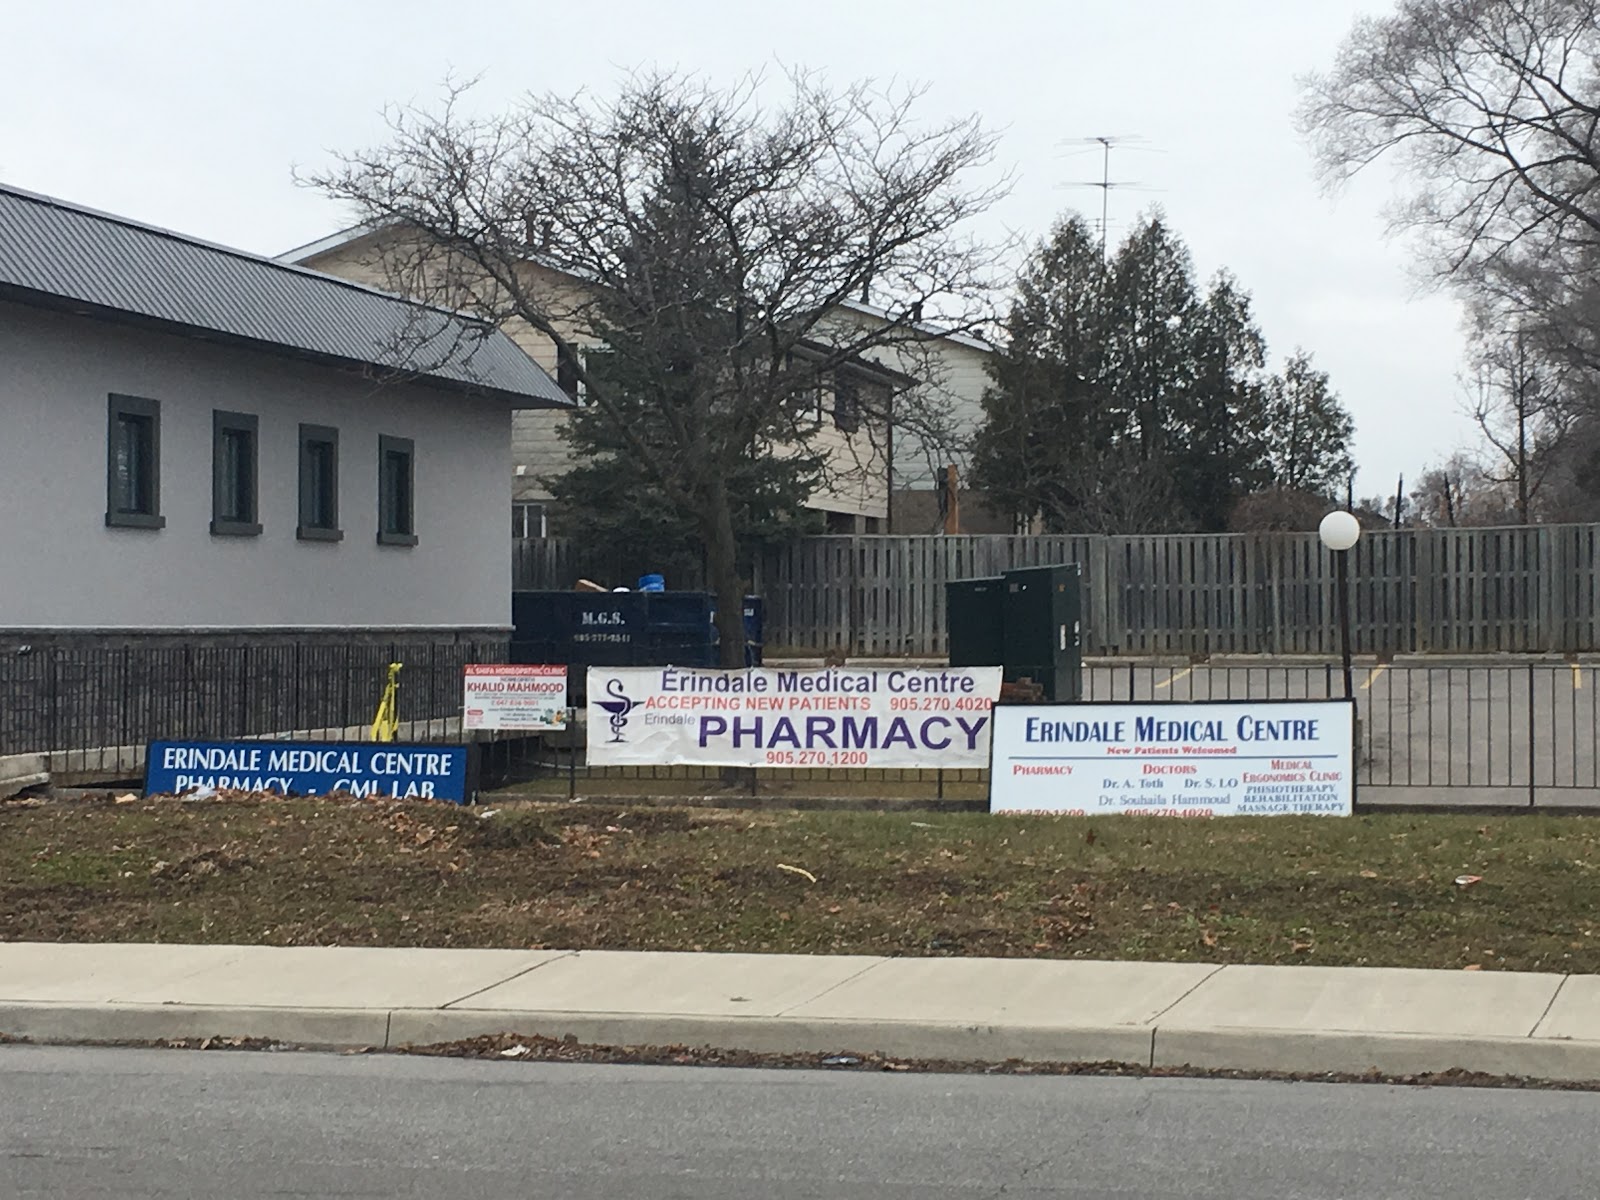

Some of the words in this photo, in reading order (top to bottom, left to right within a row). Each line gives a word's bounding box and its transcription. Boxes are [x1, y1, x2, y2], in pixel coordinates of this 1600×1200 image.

[582, 611, 626, 625] M.G.S.
[467, 682, 505, 692] KHALID
[507, 683, 564, 693] MAHMOOD
[661, 670, 768, 692] Erindale
[777, 671, 877, 693] Medical
[887, 671, 975, 693] Centre
[645, 696, 741, 710] ACCEPTING
[746, 697, 785, 710] NEW
[789, 697, 871, 711] PATIENTS
[890, 697, 992, 711] 905.270.4020
[644, 714, 696, 726] Erindale
[699, 716, 989, 750] PHARMACY
[1025, 716, 1126, 742] ERINDALE
[1134, 716, 1228, 742] MEDICAL
[1236, 714, 1320, 742] CENTRE
[1106, 747, 1132, 755] New
[1134, 747, 1179, 755] Patients
[1182, 746, 1237, 755] Welcomed
[163, 747, 262, 771] ERINDALE
[267, 750, 363, 774] MEDICAL
[370, 751, 452, 776] CENTRE
[766, 750, 868, 765] 905.270.1200
[1013, 764, 1074, 776] PHARMACY
[1143, 764, 1197, 775] DOCTORS
[1271, 759, 1313, 771] MEDICAL
[1243, 773, 1306, 784] ERGONOMICS
[1309, 770, 1342, 782] CLINIC
[1102, 778, 1120, 789] Dr.
[1122, 779, 1135, 789] A.
[1139, 778, 1164, 789] Toth
[1184, 779, 1201, 789] Dr.
[1204, 778, 1216, 789] S.
[1246, 784, 1337, 794] PHISIOTHERAPY
[391, 780, 435, 801] LAB
[1098, 795, 1116, 806] Dr.
[1119, 794, 1167, 806] Souhaila
[1172, 793, 1231, 805] Hammoud
[1243, 793, 1339, 803] REHABILITATION
[1237, 803, 1290, 812] MASSAGE
[1293, 802, 1345, 811] THERAPY
